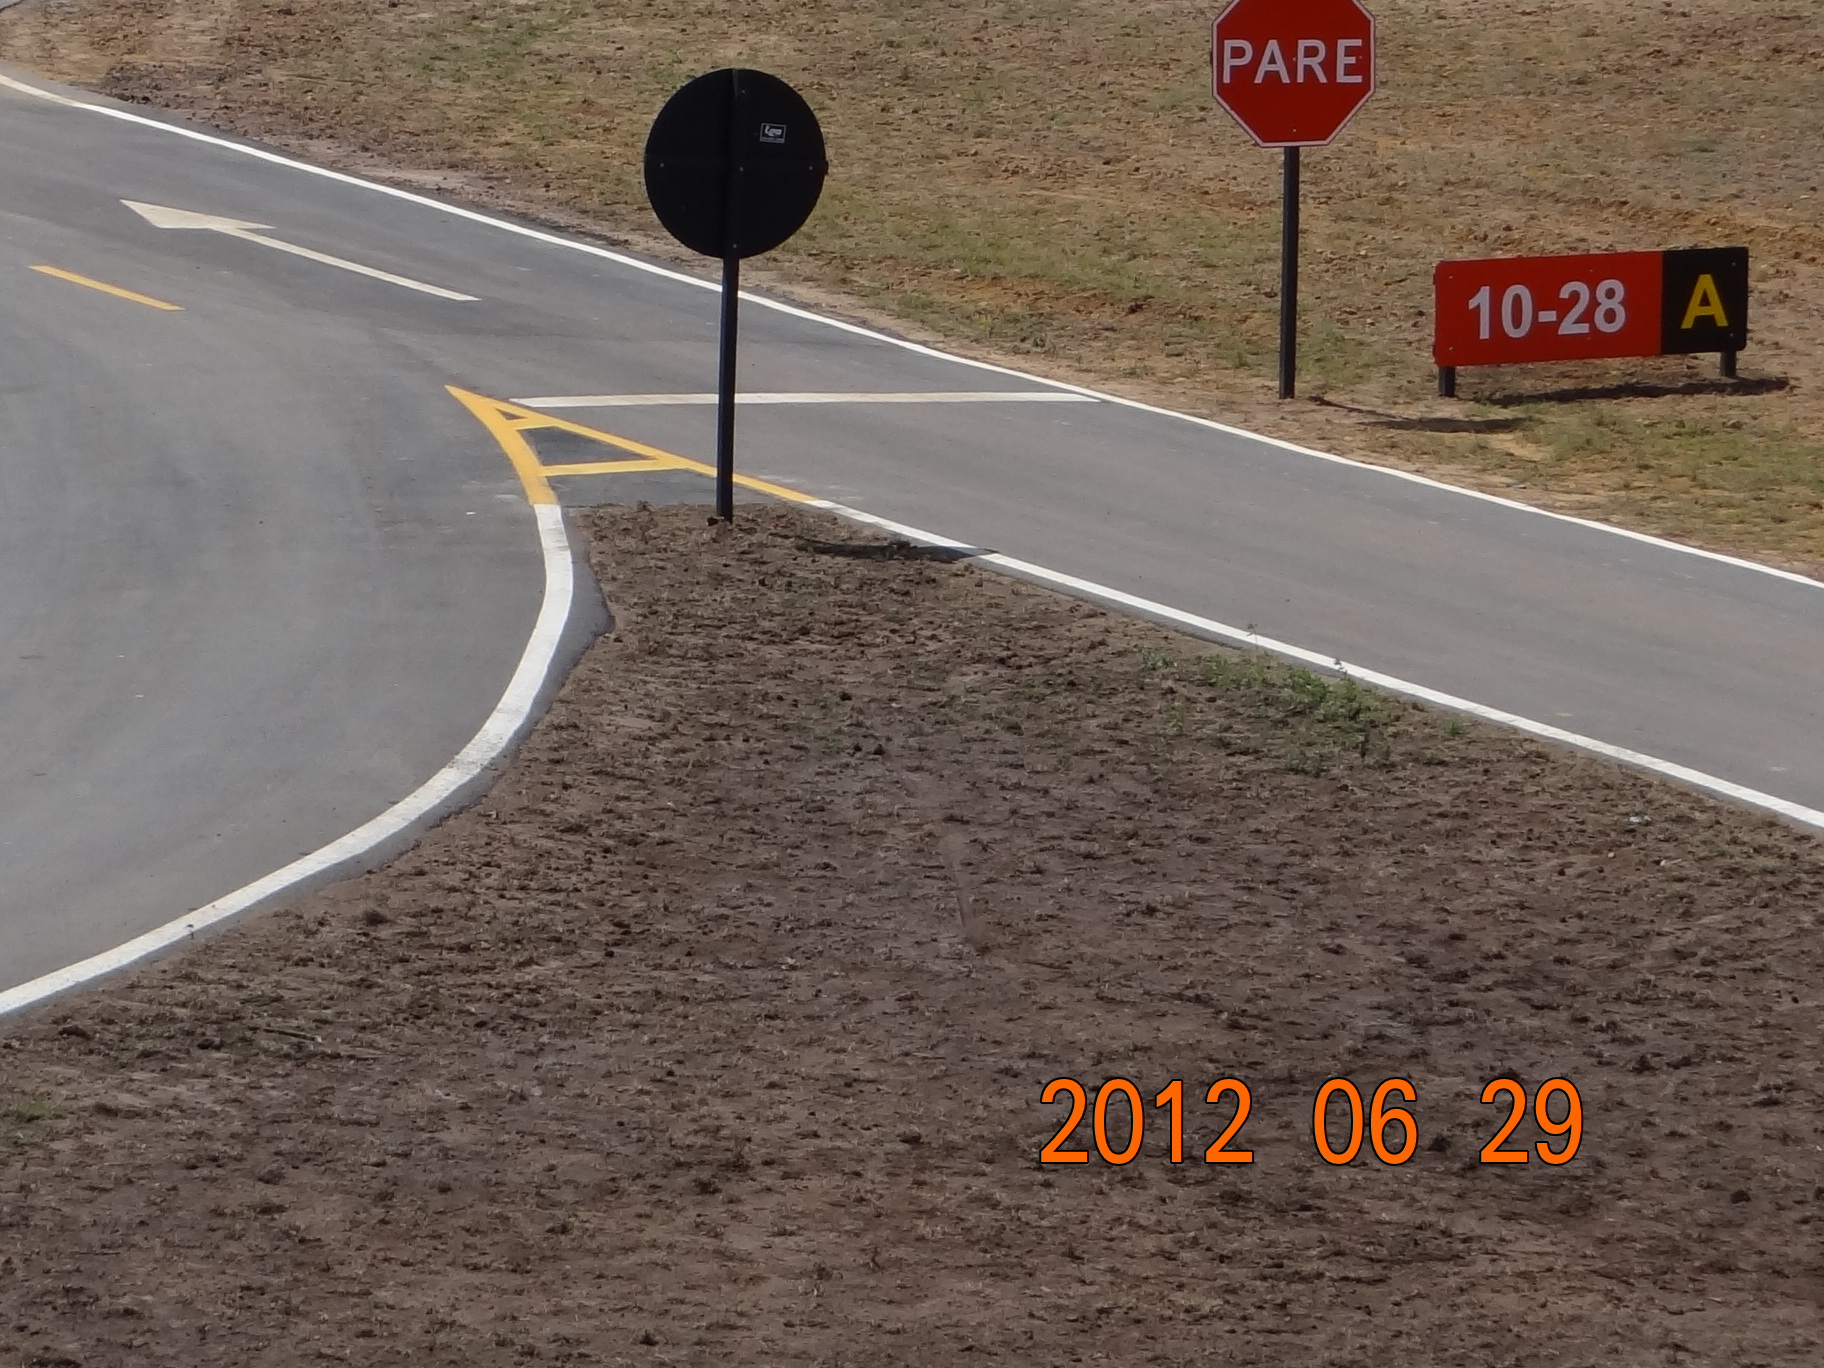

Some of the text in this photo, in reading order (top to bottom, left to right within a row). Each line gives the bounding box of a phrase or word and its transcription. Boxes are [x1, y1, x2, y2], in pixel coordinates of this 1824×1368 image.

[1222, 39, 1364, 84] PARE
[1468, 273, 1729, 340] 10-28 A
